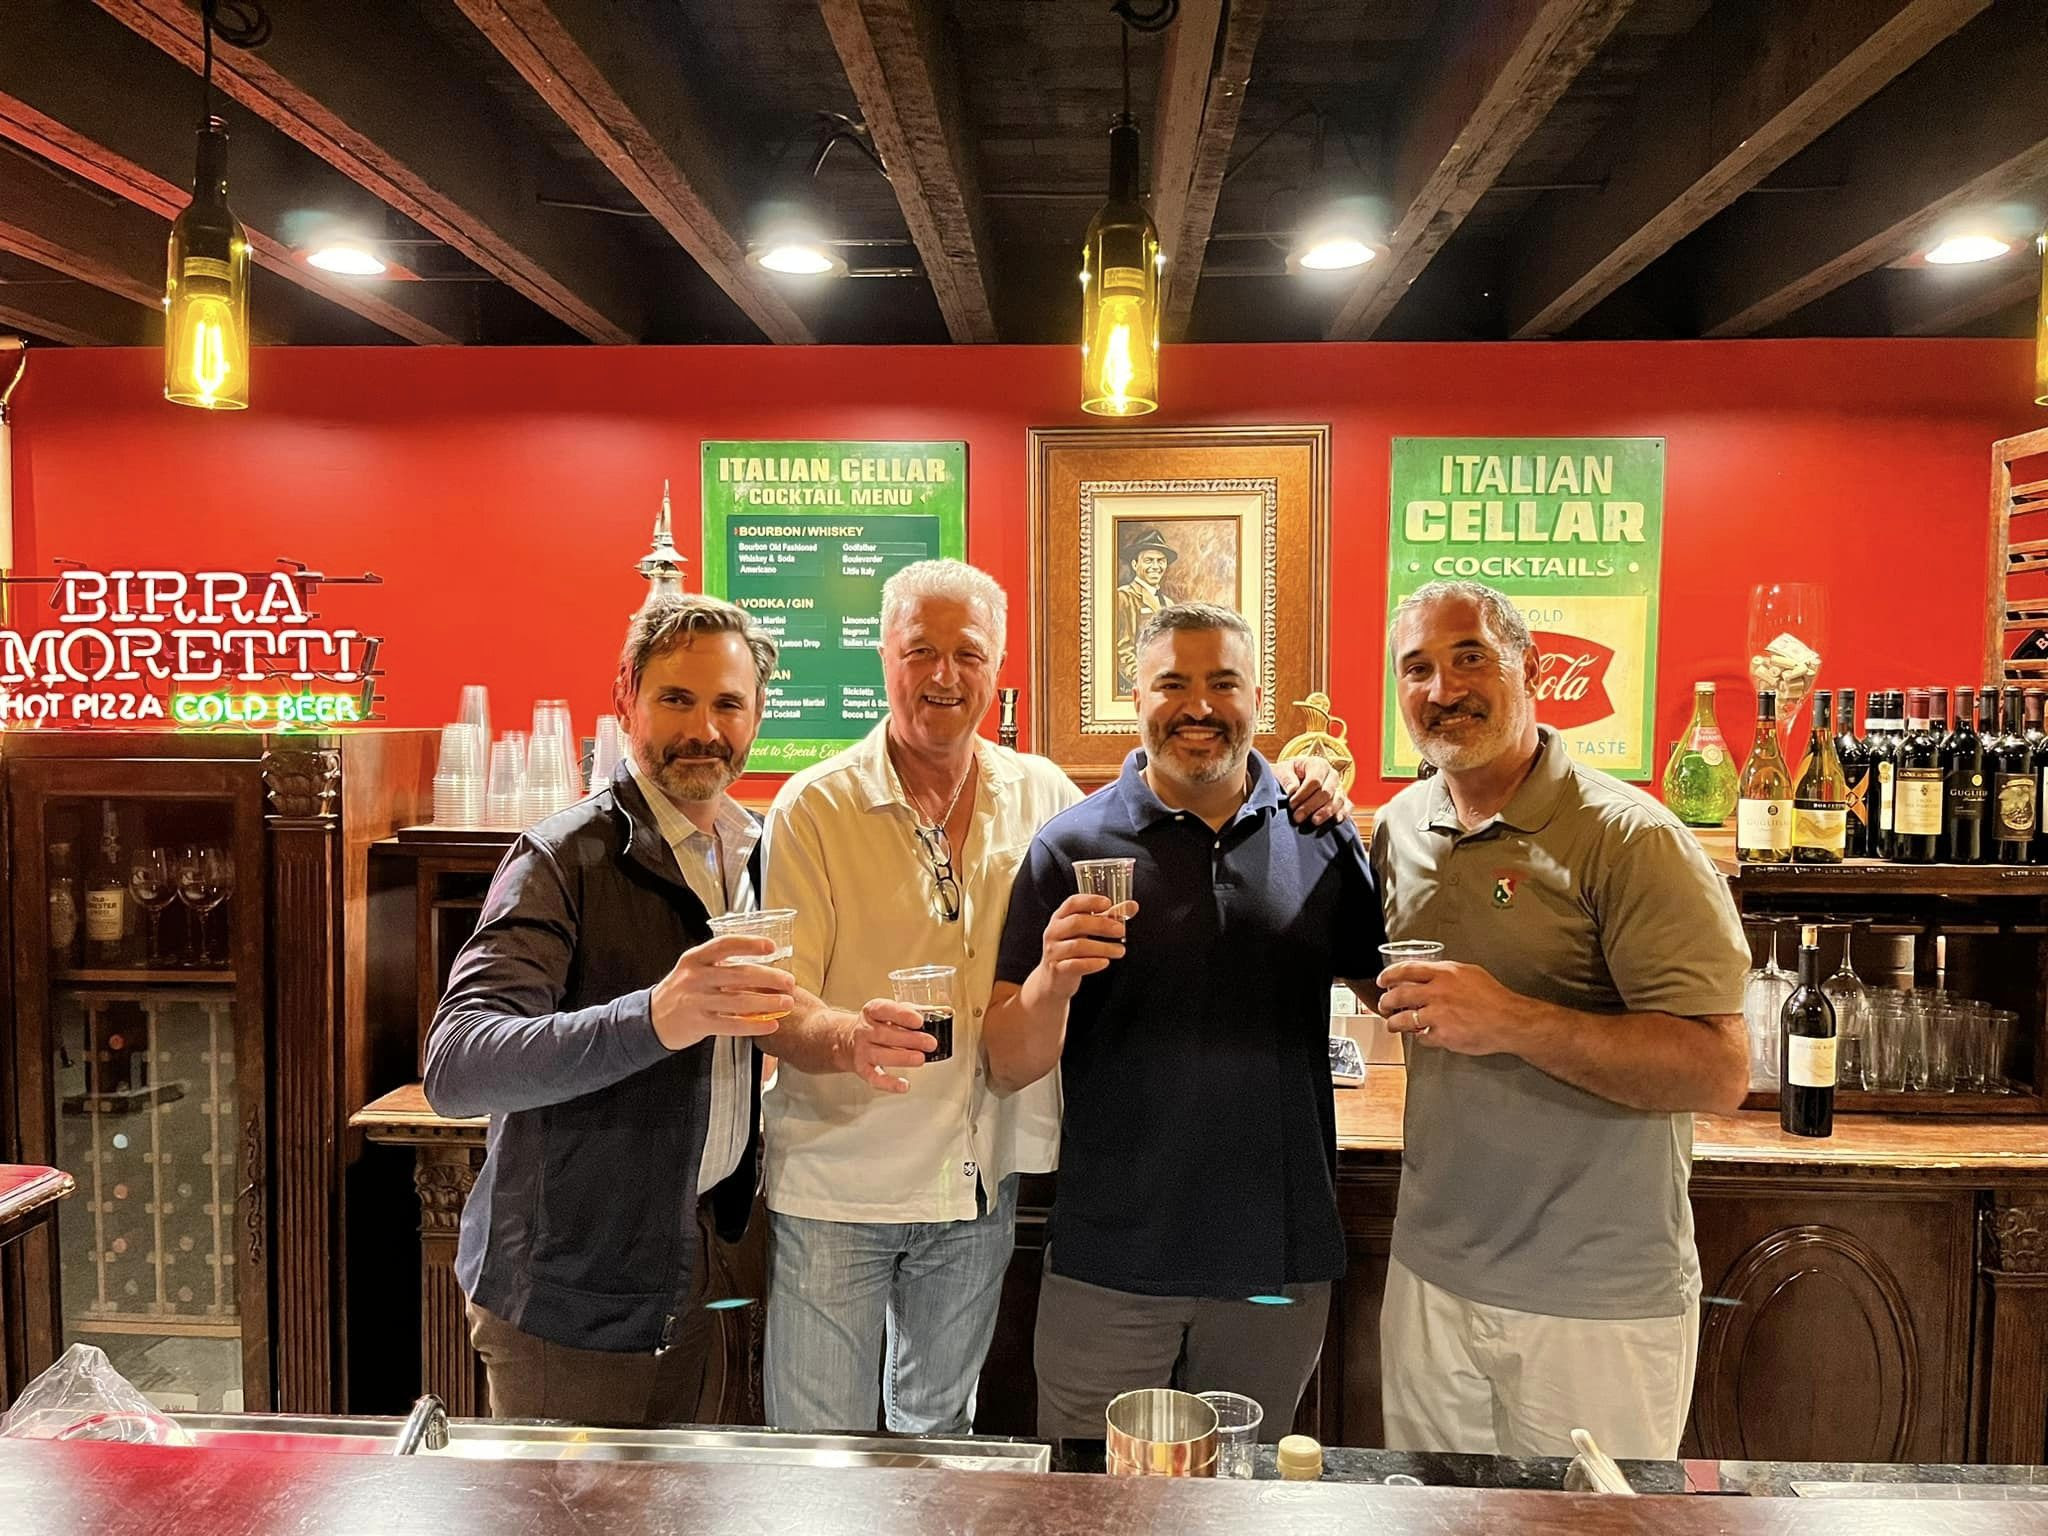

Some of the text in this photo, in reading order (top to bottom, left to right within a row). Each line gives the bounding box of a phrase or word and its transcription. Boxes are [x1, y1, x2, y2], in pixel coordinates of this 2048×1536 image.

[719, 457, 946, 482] ITALIAN CELLAR
[1441, 455, 1614, 494] ITALIAN
[749, 488, 913, 505] COCKTAIL MENU
[1404, 501, 1647, 543] CELLAR
[739, 543, 818, 552] Bourbon Old Fashioned
[842, 543, 877, 552] Godfather
[738, 554, 768, 564] Whiskey
[777, 554, 796, 563] Soda
[740, 565, 777, 574] Americano
[1433, 556, 1615, 577] COCKTAILS
[842, 567, 876, 577] Little Italy
[59, 570, 308, 625] BIRRA
[762, 616, 787, 624] Martini
[842, 616, 880, 624] Limoncello
[842, 627, 870, 637] Negroni
[779, 639, 803, 648] Lemon
[803, 639, 821, 649] Drop
[0, 627, 359, 683] MORETTI
[0, 692, 360, 722] HOT PIZZA COLD BEER
[771, 698, 802, 708] Espresso
[802, 698, 826, 707] Martini
[842, 699, 871, 709] Campari
[773, 710, 801, 719] Cocktail
[842, 710, 879, 719] Bocce Ball
[750, 742, 844, 759] eed to Speak Eas
[1576, 741, 1627, 755] TASTE
